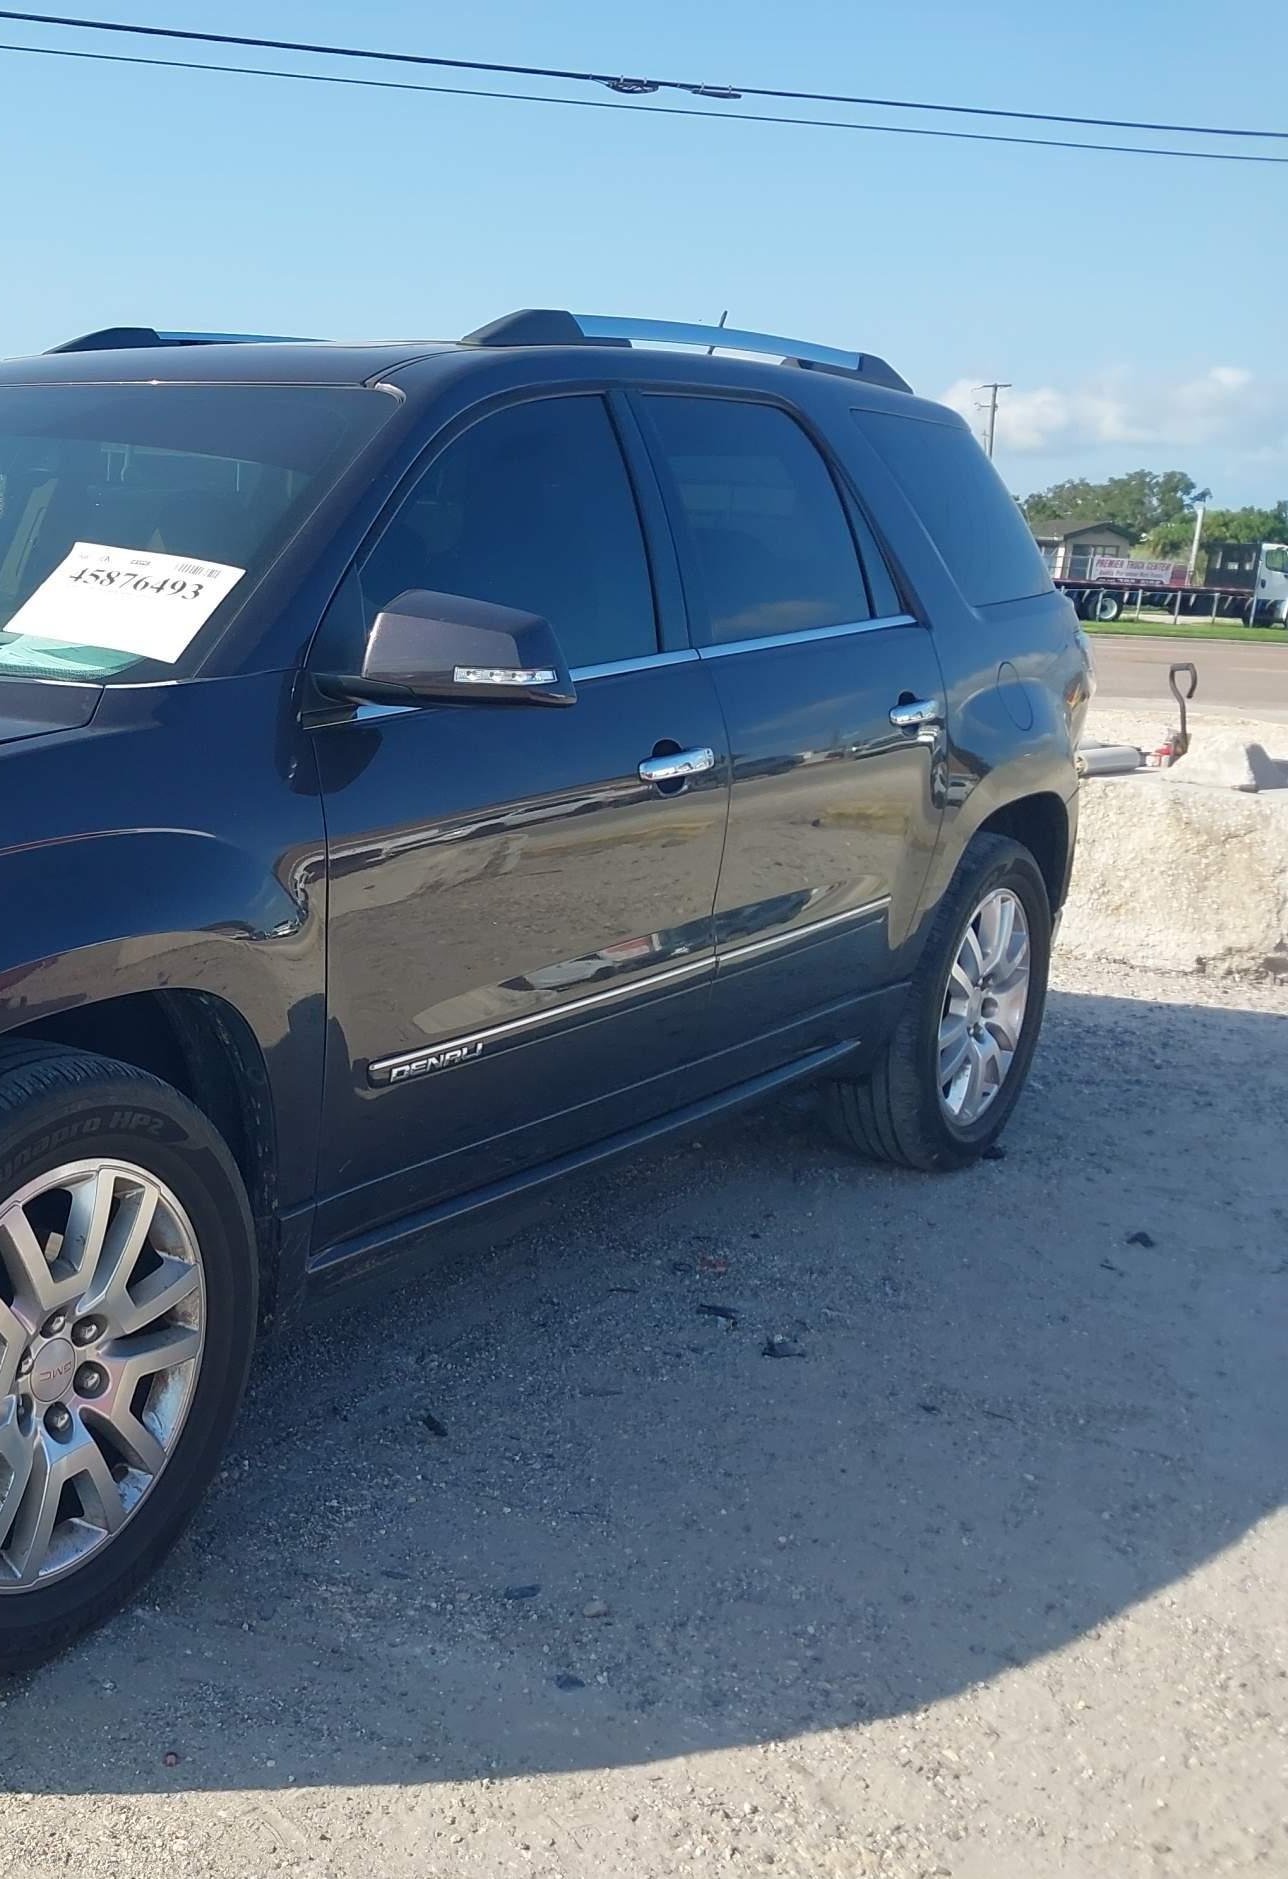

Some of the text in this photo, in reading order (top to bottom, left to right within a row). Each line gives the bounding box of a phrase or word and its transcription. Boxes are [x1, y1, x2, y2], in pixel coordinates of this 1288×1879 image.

[69, 568, 204, 600] 45876493
[390, 1042, 483, 1082] DENALI
[109, 1111, 166, 1136] HP2
